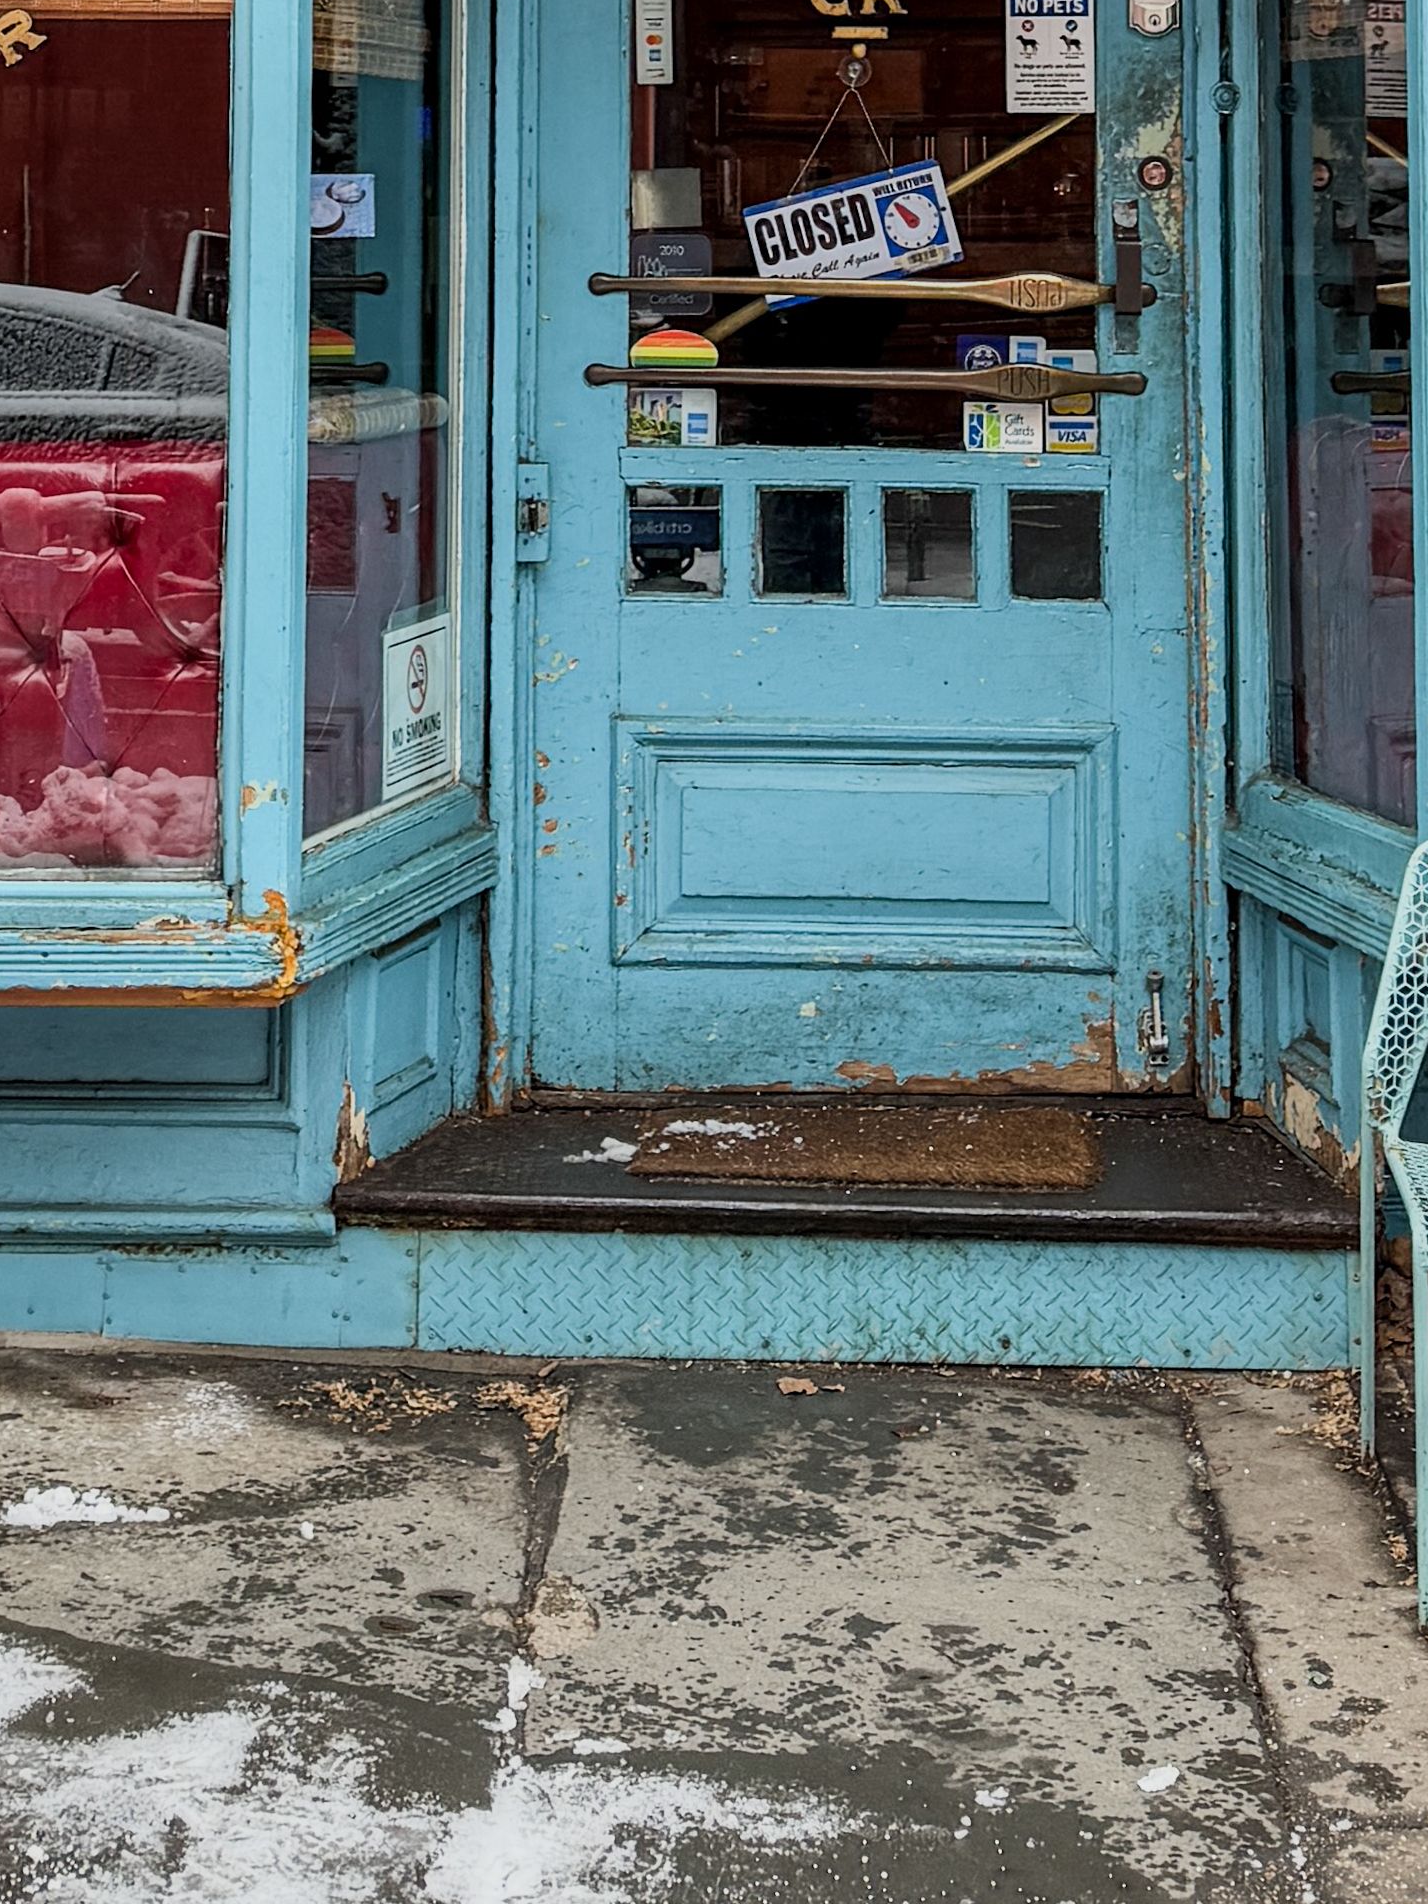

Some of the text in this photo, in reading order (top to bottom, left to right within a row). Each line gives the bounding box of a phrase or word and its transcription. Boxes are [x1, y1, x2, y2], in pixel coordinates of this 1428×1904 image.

[753, 193, 876, 266] CLOSED
[812, 259, 839, 278] Call
[843, 252, 880, 269] Again
[996, 367, 1050, 396] PUSH
[1004, 413, 1025, 425] Gift
[1004, 425, 1035, 437] Cards
[1058, 430, 1087, 442] VISA
[392, 711, 442, 749] NO SMOKING
